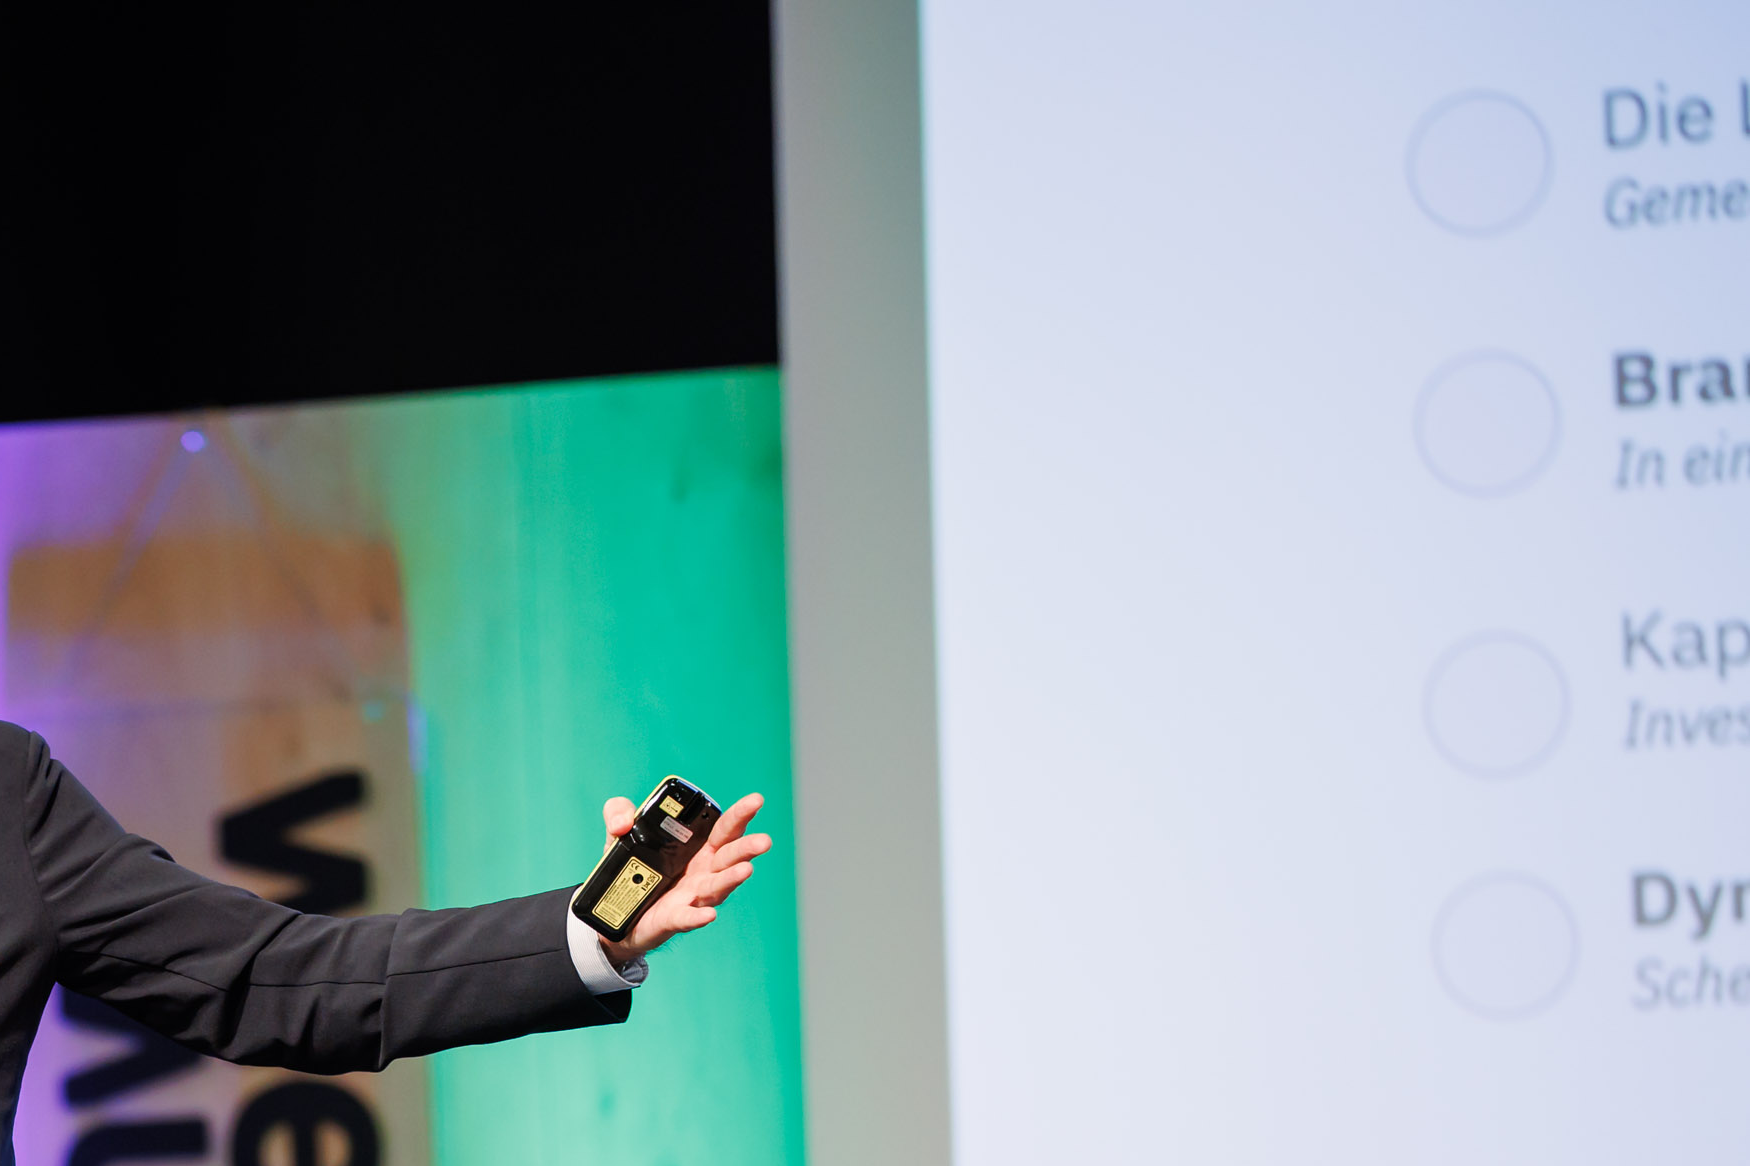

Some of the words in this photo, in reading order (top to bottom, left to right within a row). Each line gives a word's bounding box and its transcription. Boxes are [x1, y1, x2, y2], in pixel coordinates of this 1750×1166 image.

[1602, 82, 1714, 150] Die
[1613, 350, 1750, 408] Bra
[1616, 438, 1664, 490] In
